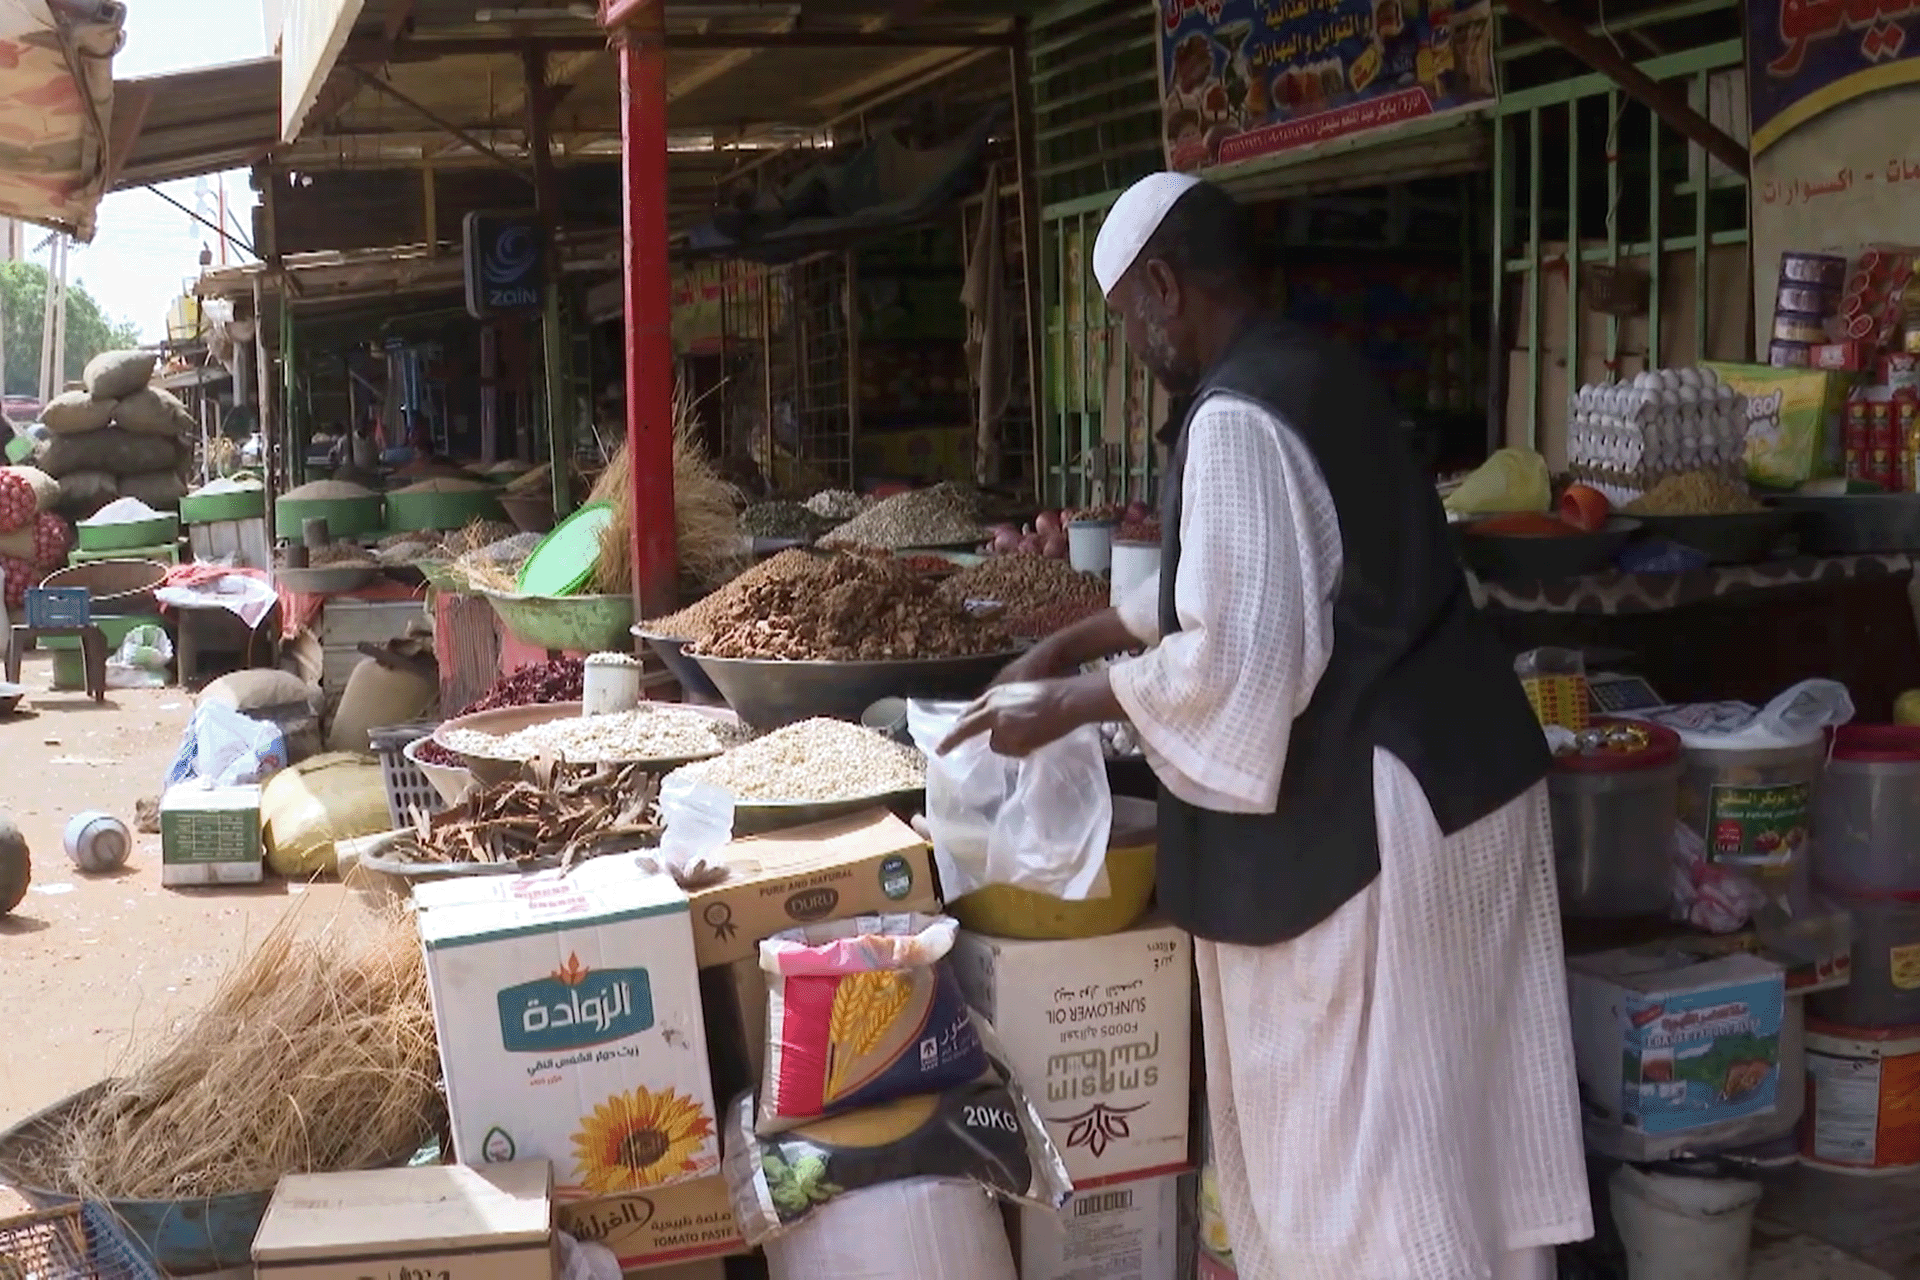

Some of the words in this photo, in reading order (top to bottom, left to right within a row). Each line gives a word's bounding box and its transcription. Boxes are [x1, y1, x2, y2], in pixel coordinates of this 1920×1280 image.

[1252, 32, 1302, 68] البهارات
[760, 882, 787, 897] PURE
[787, 878, 809, 892] AND
[810, 868, 855, 888] NATURAL
[790, 892, 835, 913] DURU
[1053, 987, 1076, 1003] زيت
[1079, 984, 1101, 1001] دوار
[1105, 979, 1144, 998] الشمس
[522, 980, 632, 1033] الزوادة
[1045, 1008, 1067, 1025] OIL
[1068, 996, 1147, 1023] SUNFLOWER
[1100, 1021, 1139, 1038] FOODS
[526, 1058, 554, 1077] النقي
[554, 1051, 593, 1069] الشمس
[1046, 1065, 1159, 1104] SMASIM
[962, 1105, 1019, 1134] 20KG
[650, 1215, 693, 1232] طبيعية
[694, 1210, 732, 1225] صلصة
[653, 1232, 699, 1248] TOMATO
[701, 1226, 733, 1242] PASTE
